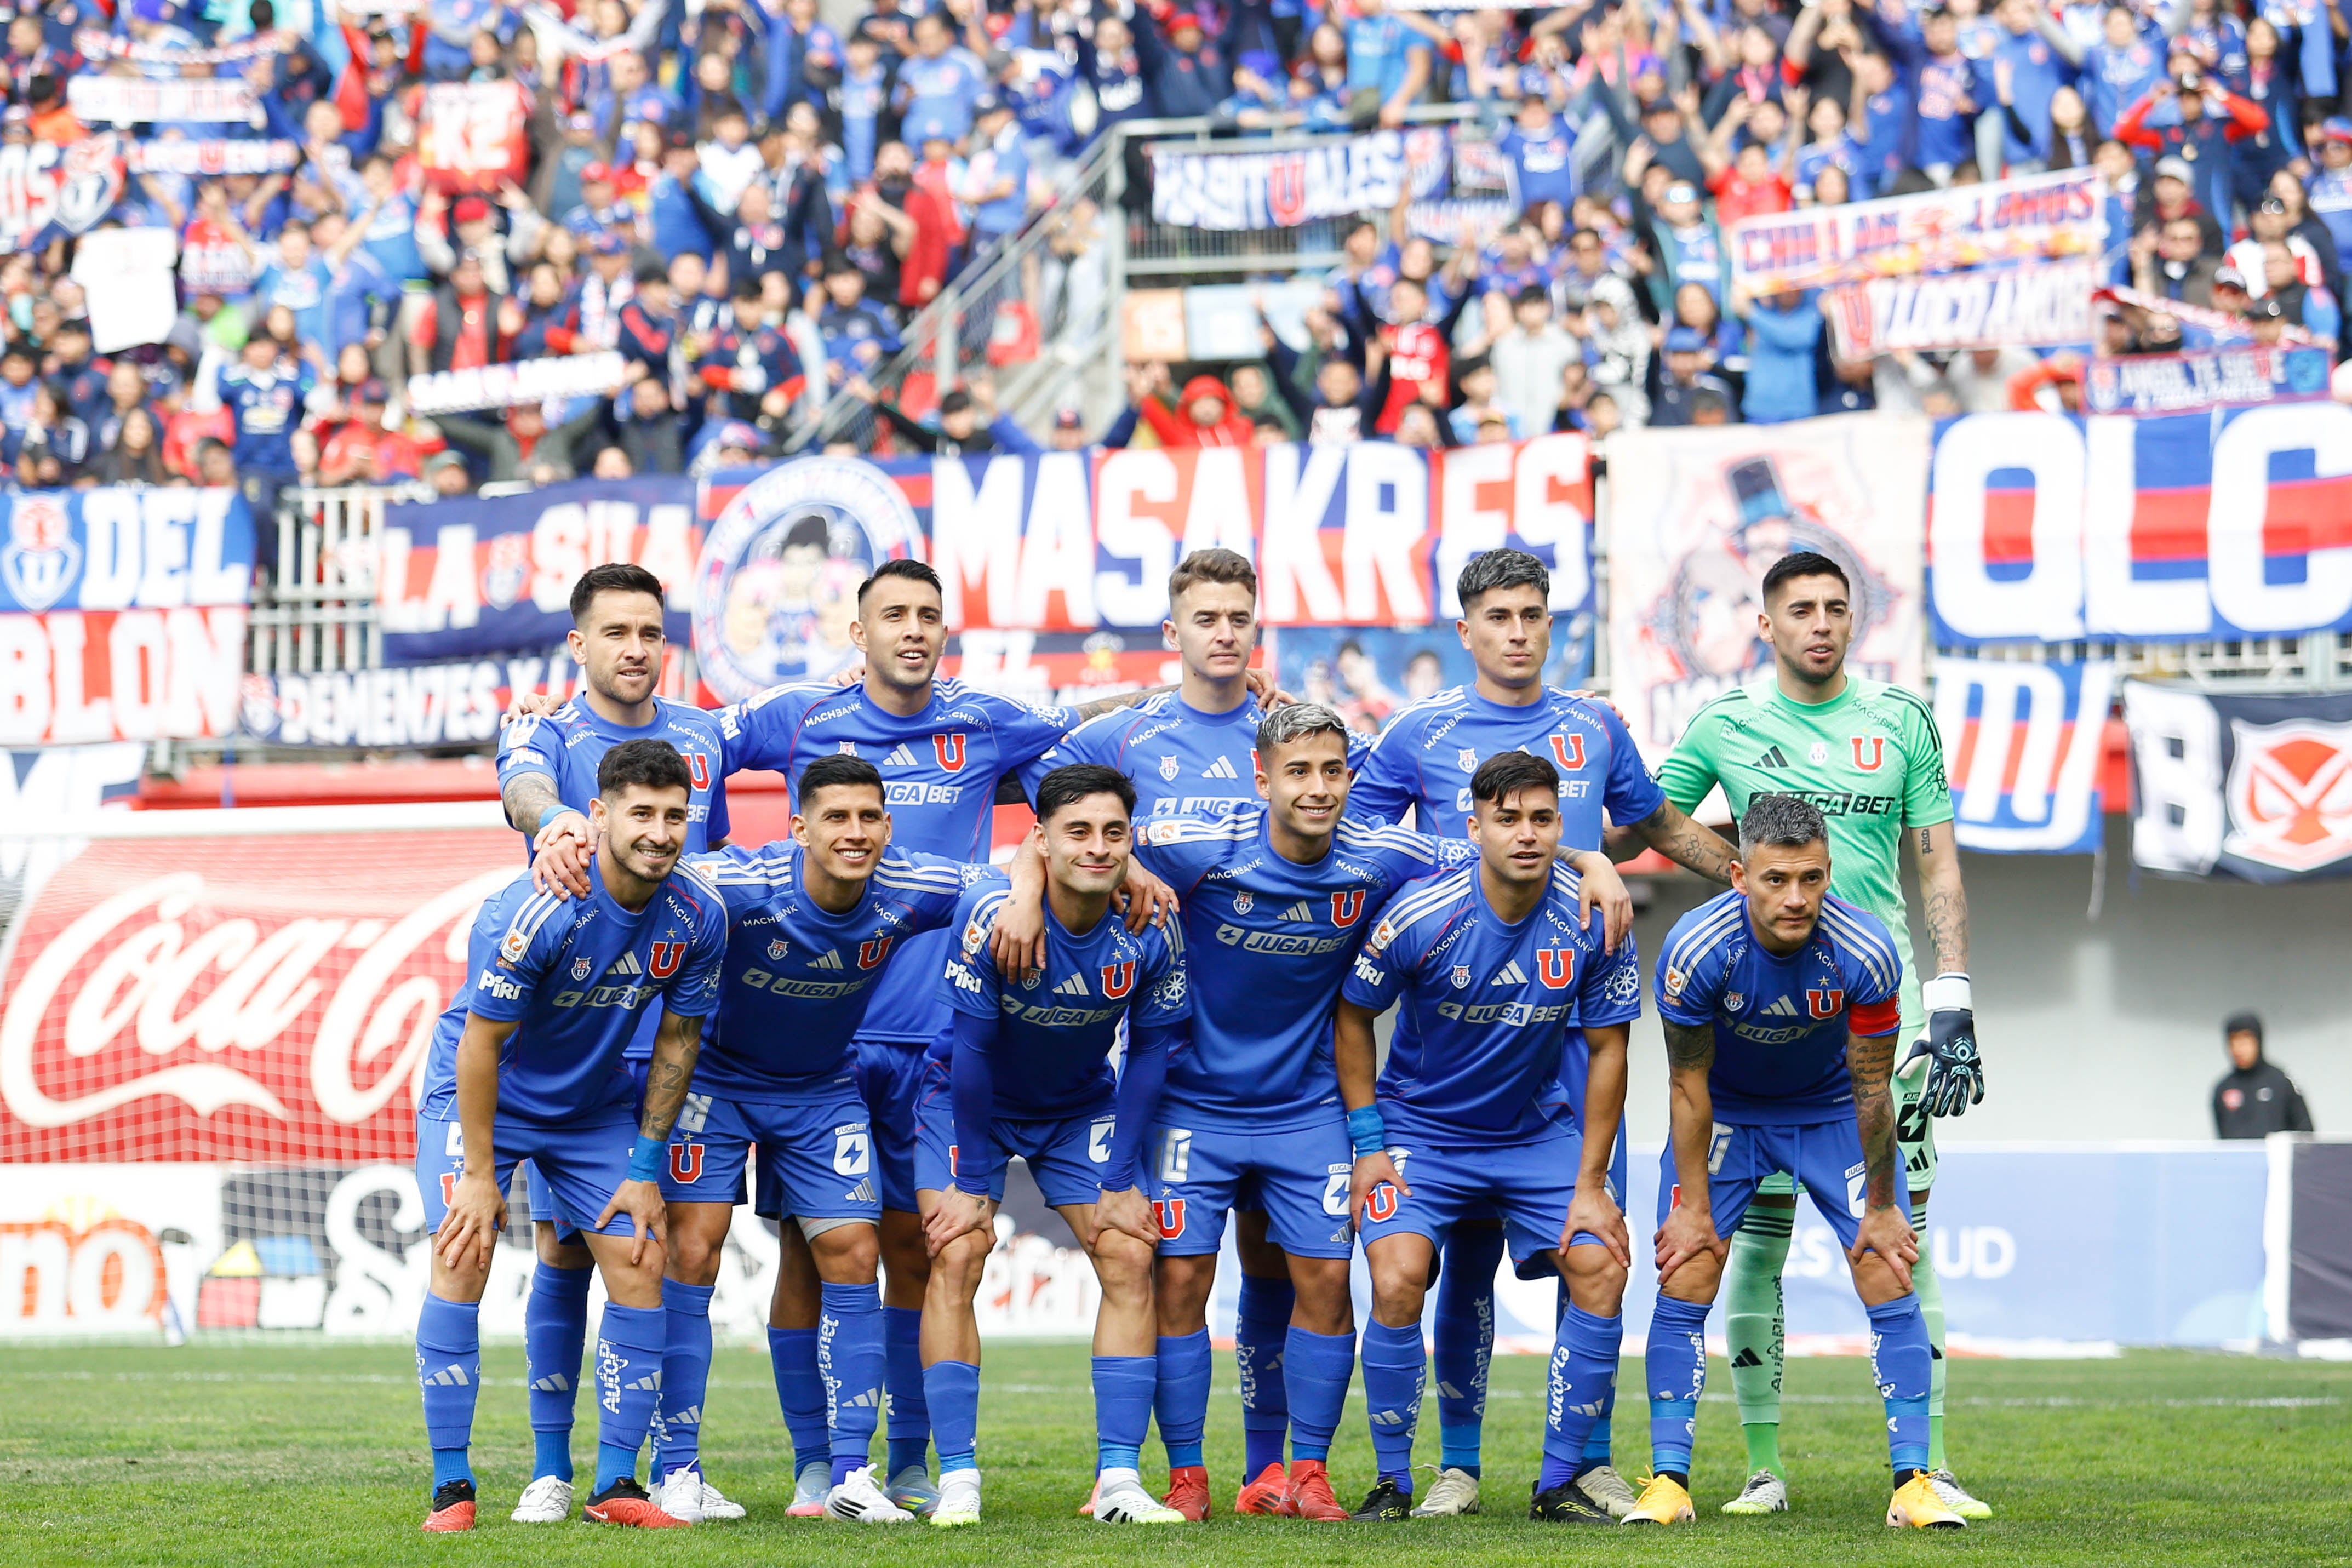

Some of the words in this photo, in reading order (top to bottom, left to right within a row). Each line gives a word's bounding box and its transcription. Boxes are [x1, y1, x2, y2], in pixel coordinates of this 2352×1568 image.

[79, 488, 250, 609] DEL
[932, 436, 1592, 629] MASAKRES
[379, 523, 481, 633] LA
[804, 702, 862, 728] MACHBANK
[667, 720, 719, 758] MACHBANK
[932, 733, 967, 774] U
[1548, 733, 1587, 771] U
[1849, 735, 1886, 773] U
[927, 785, 963, 804] BET
[1851, 796, 1896, 815] BET
[1206, 857, 1263, 881] MACHBANK
[1335, 858, 1387, 890] MACHBANK
[742, 903, 799, 928] MACHBANK
[1330, 889, 1367, 929] U
[1252, 933, 1311, 954] JUGA
[1314, 932, 1353, 955] BET
[1426, 915, 1478, 960] MACHBANK
[1544, 908, 1594, 955] MACHBANK
[649, 941, 688, 980] U
[856, 936, 894, 971] U
[1536, 948, 1575, 990] U
[776, 979, 840, 997] JUGA
[1101, 959, 1136, 1000] U
[1025, 1007, 1087, 1026] JUGA
[1468, 1003, 1525, 1025] JUGA
[1530, 1003, 1573, 1023] BET
[1806, 988, 1844, 1021] U
[1738, 1026, 1799, 1043] JUGA
[669, 1143, 705, 1184] U
[1152, 1198, 1186, 1240] U
[1365, 1185, 1398, 1223] U
